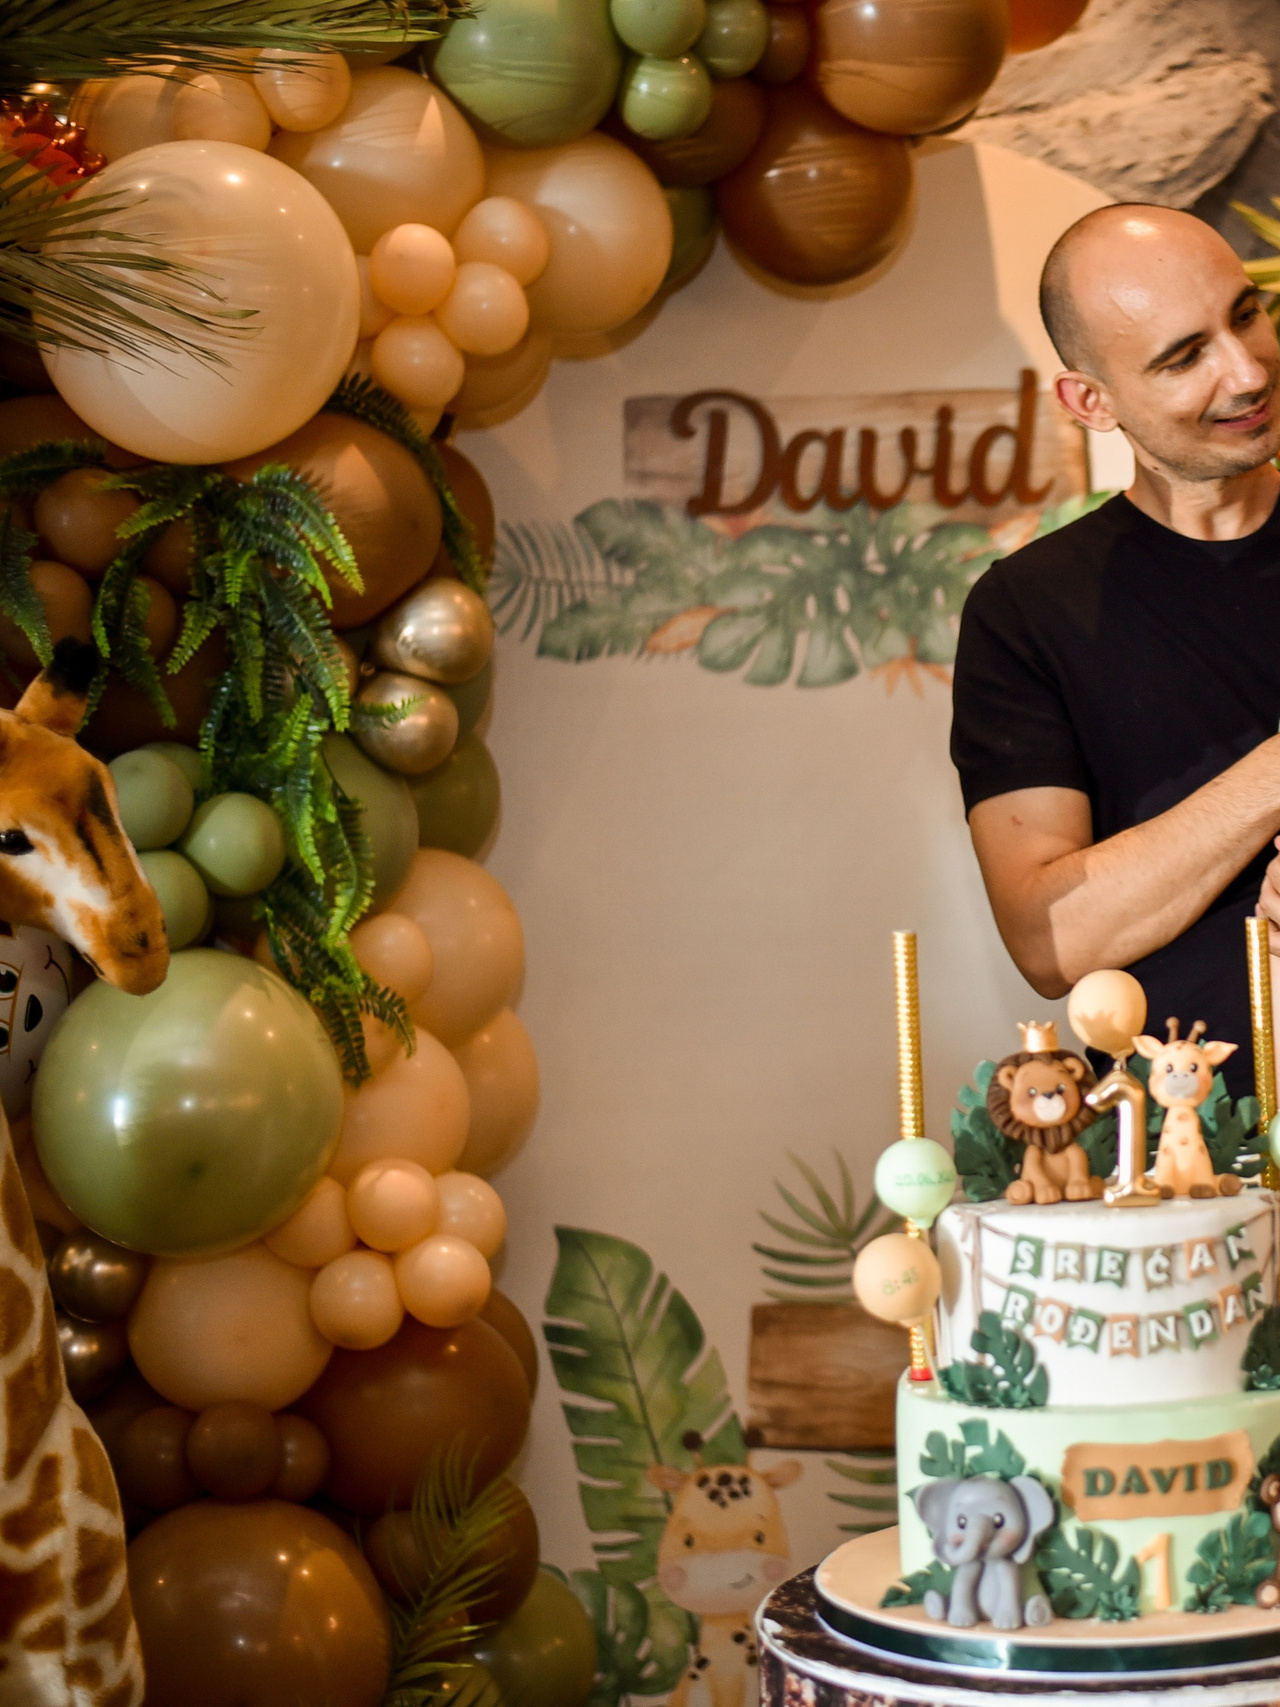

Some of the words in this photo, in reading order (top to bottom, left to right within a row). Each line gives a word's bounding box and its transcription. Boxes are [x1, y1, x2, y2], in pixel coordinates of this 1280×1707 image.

[669, 368, 1055, 517] David
[1083, 1458, 1236, 1497] DAVID
[1137, 1533, 1173, 1611] 1
